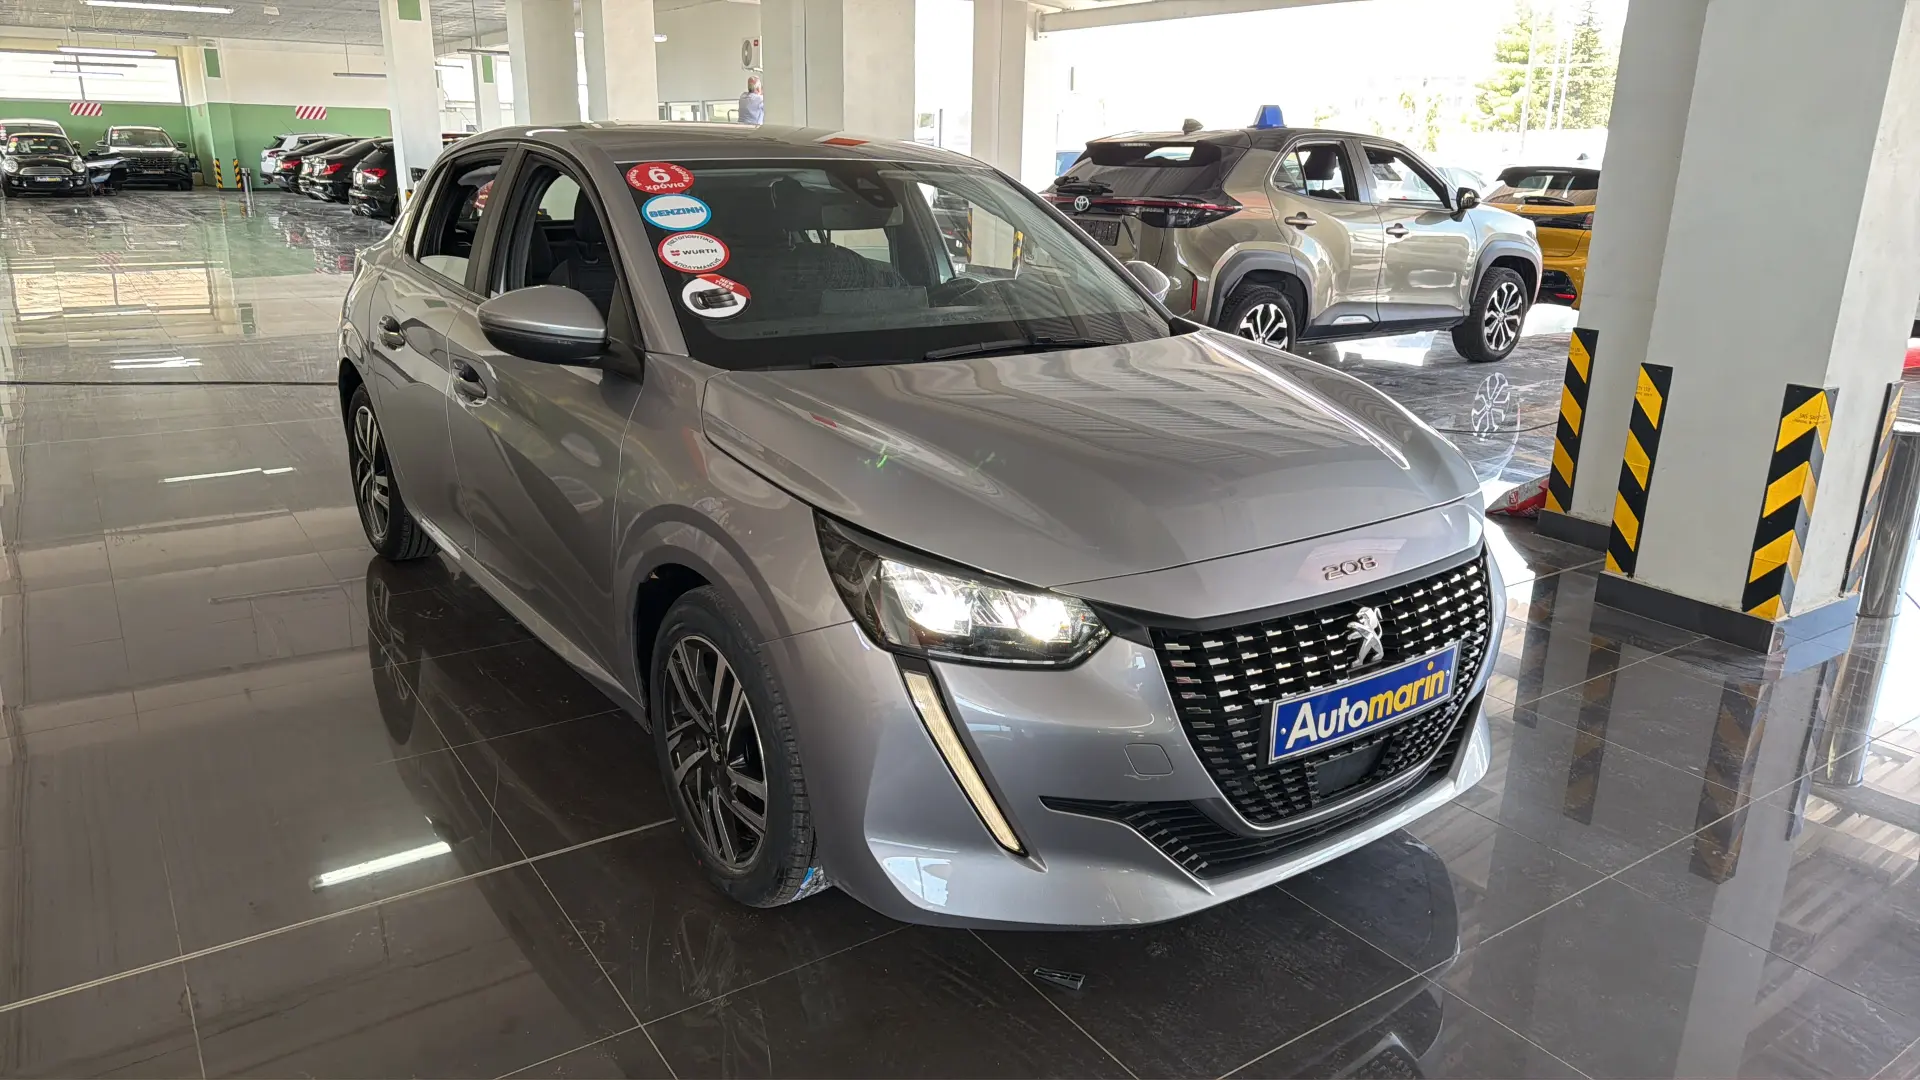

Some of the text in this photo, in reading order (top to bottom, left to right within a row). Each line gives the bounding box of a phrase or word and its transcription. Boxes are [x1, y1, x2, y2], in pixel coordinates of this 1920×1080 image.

[648, 168, 671, 183] 6
[645, 182, 686, 191] χρόνια
[1322, 555, 1379, 581] 208
[1284, 661, 1445, 750] Automarin
